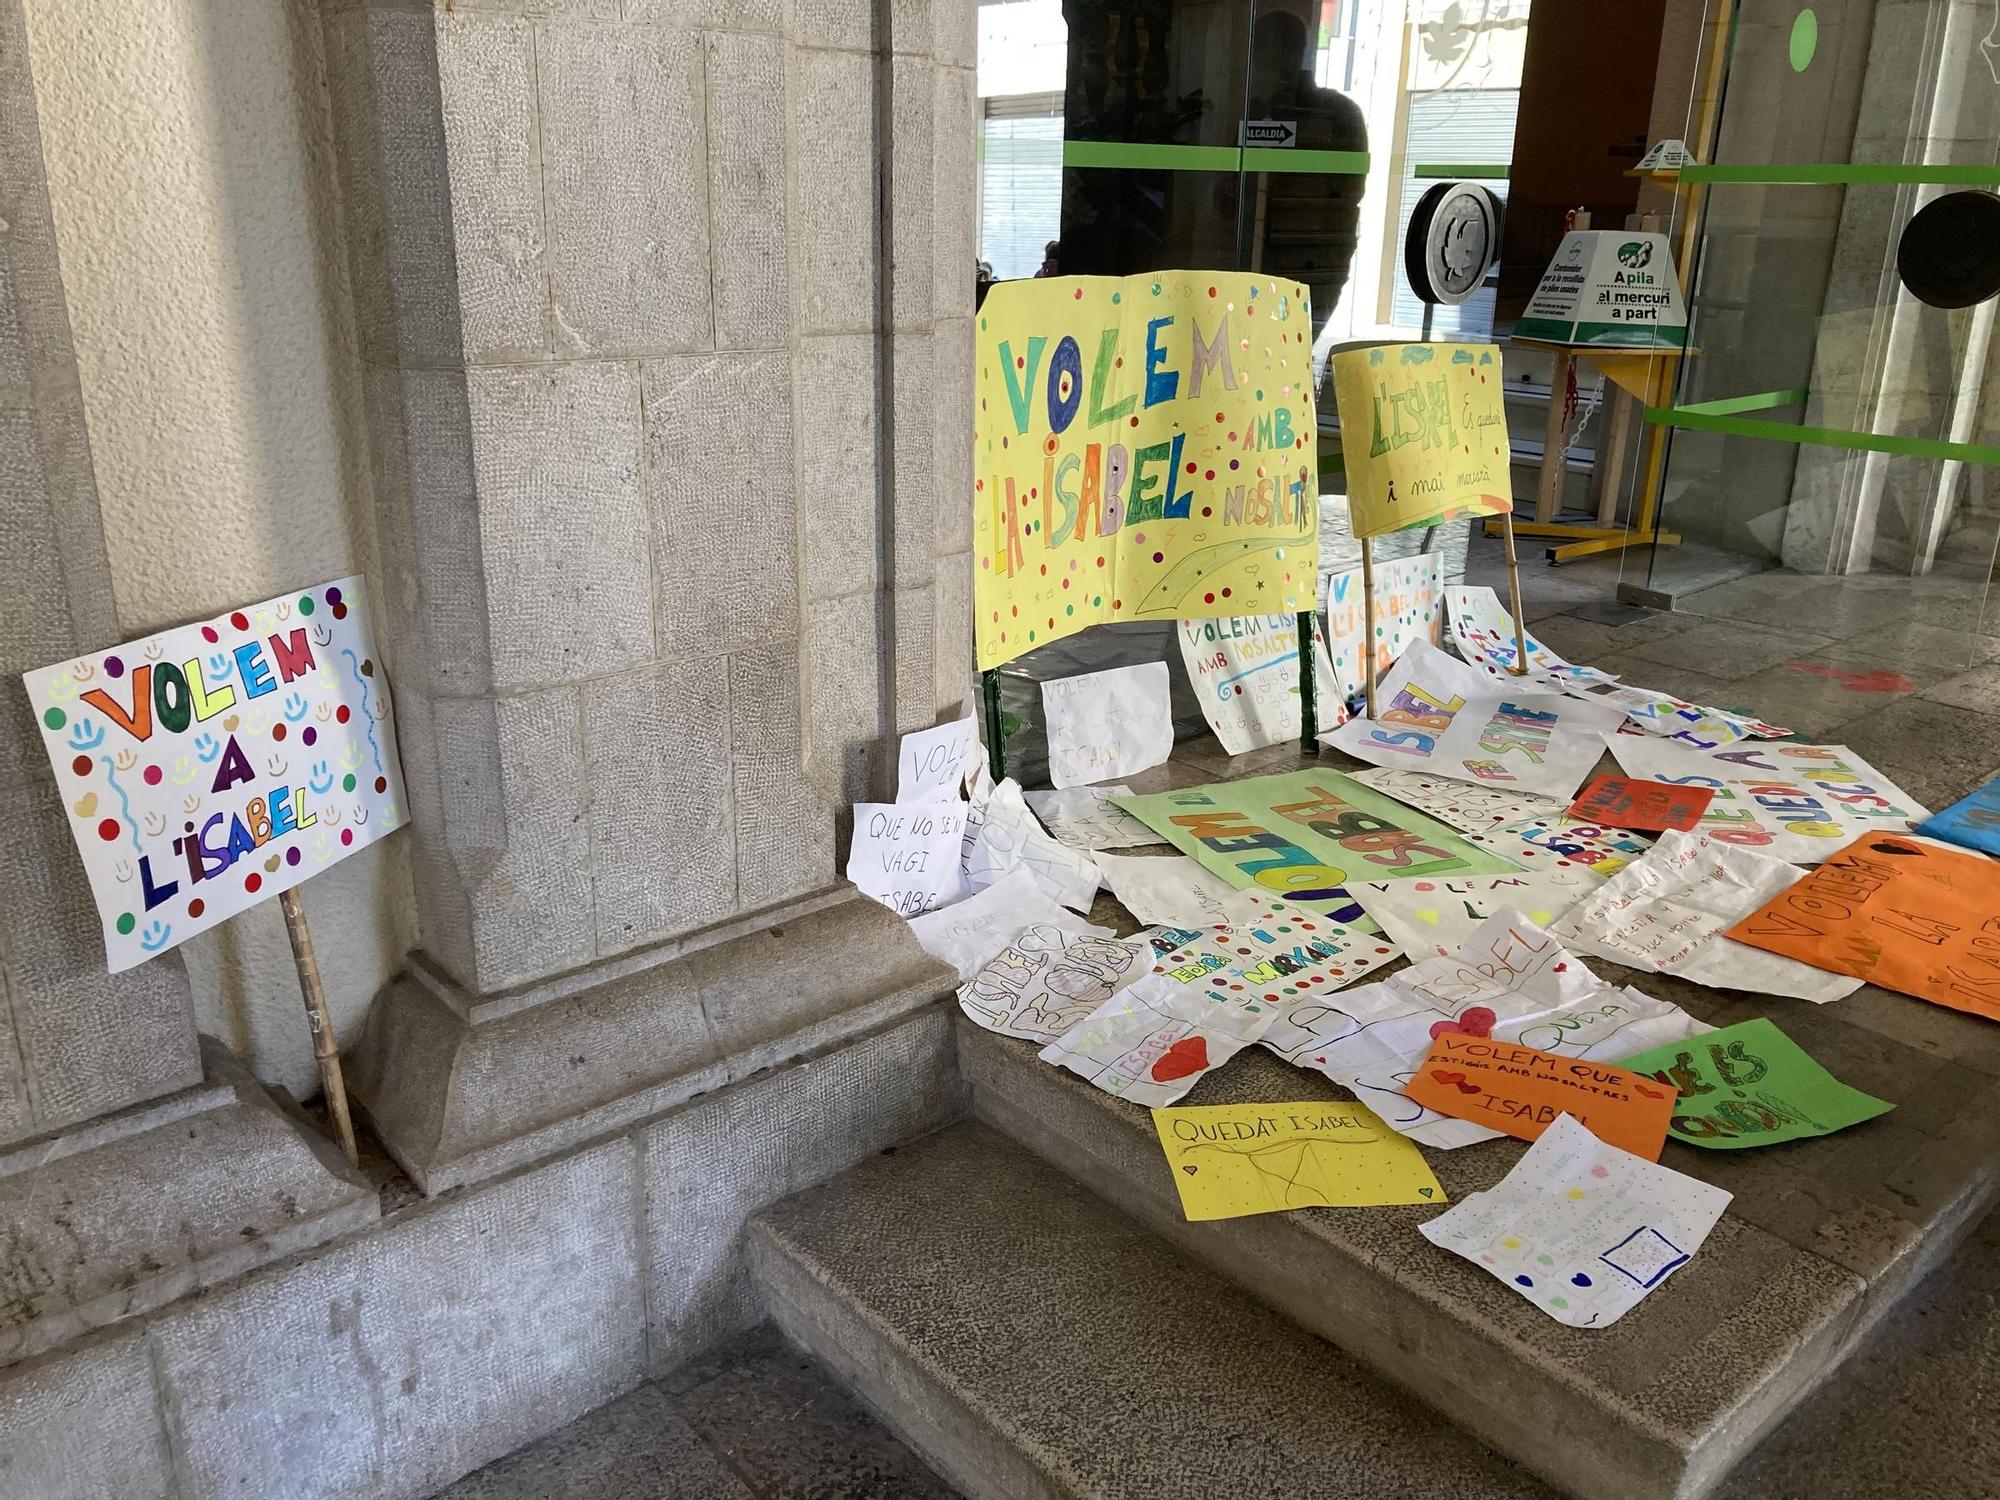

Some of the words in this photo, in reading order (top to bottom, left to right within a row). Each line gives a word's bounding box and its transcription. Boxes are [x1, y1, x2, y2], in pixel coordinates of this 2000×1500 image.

[1599, 289, 1610, 302] el
[1614, 291, 1671, 304] mercuri
[1614, 272, 1625, 283] A
[1627, 272, 1655, 286] pila
[1612, 308, 1621, 318] a
[1626, 308, 1657, 321] part
[998, 311, 1239, 436] VOLEM
[1241, 407, 1297, 453] AMB
[1411, 473, 1445, 496] mai
[992, 475, 1024, 578] LA
[1187, 616, 1262, 647] VOLEM
[80, 628, 316, 742] VOLEM
[1197, 652, 1228, 675] AMB
[1358, 682, 1467, 758] ISABEL
[211, 734, 255, 794] A
[870, 813, 904, 840] QUE
[909, 815, 932, 836] NO
[882, 850, 931, 873] VAGI
[1169, 812, 1367, 925] VOLEM
[879, 890, 938, 914] ISABE
[1748, 855, 1903, 938] VOLEM
[1871, 908, 1961, 946] LA
[958, 946, 1050, 1028] ISABEL
[1411, 927, 1549, 1008] ISABEL
[1118, 1026, 1182, 1077] ISABEL
[1446, 1038, 1556, 1071] VOLEM
[1570, 1064, 1624, 1087] QUE
[1706, 1039, 1770, 1088] ES
[1497, 1064, 1530, 1078] AMB
[1536, 1072, 1630, 1102] NOSALTRES
[1287, 1113, 1375, 1132] ISABEL
